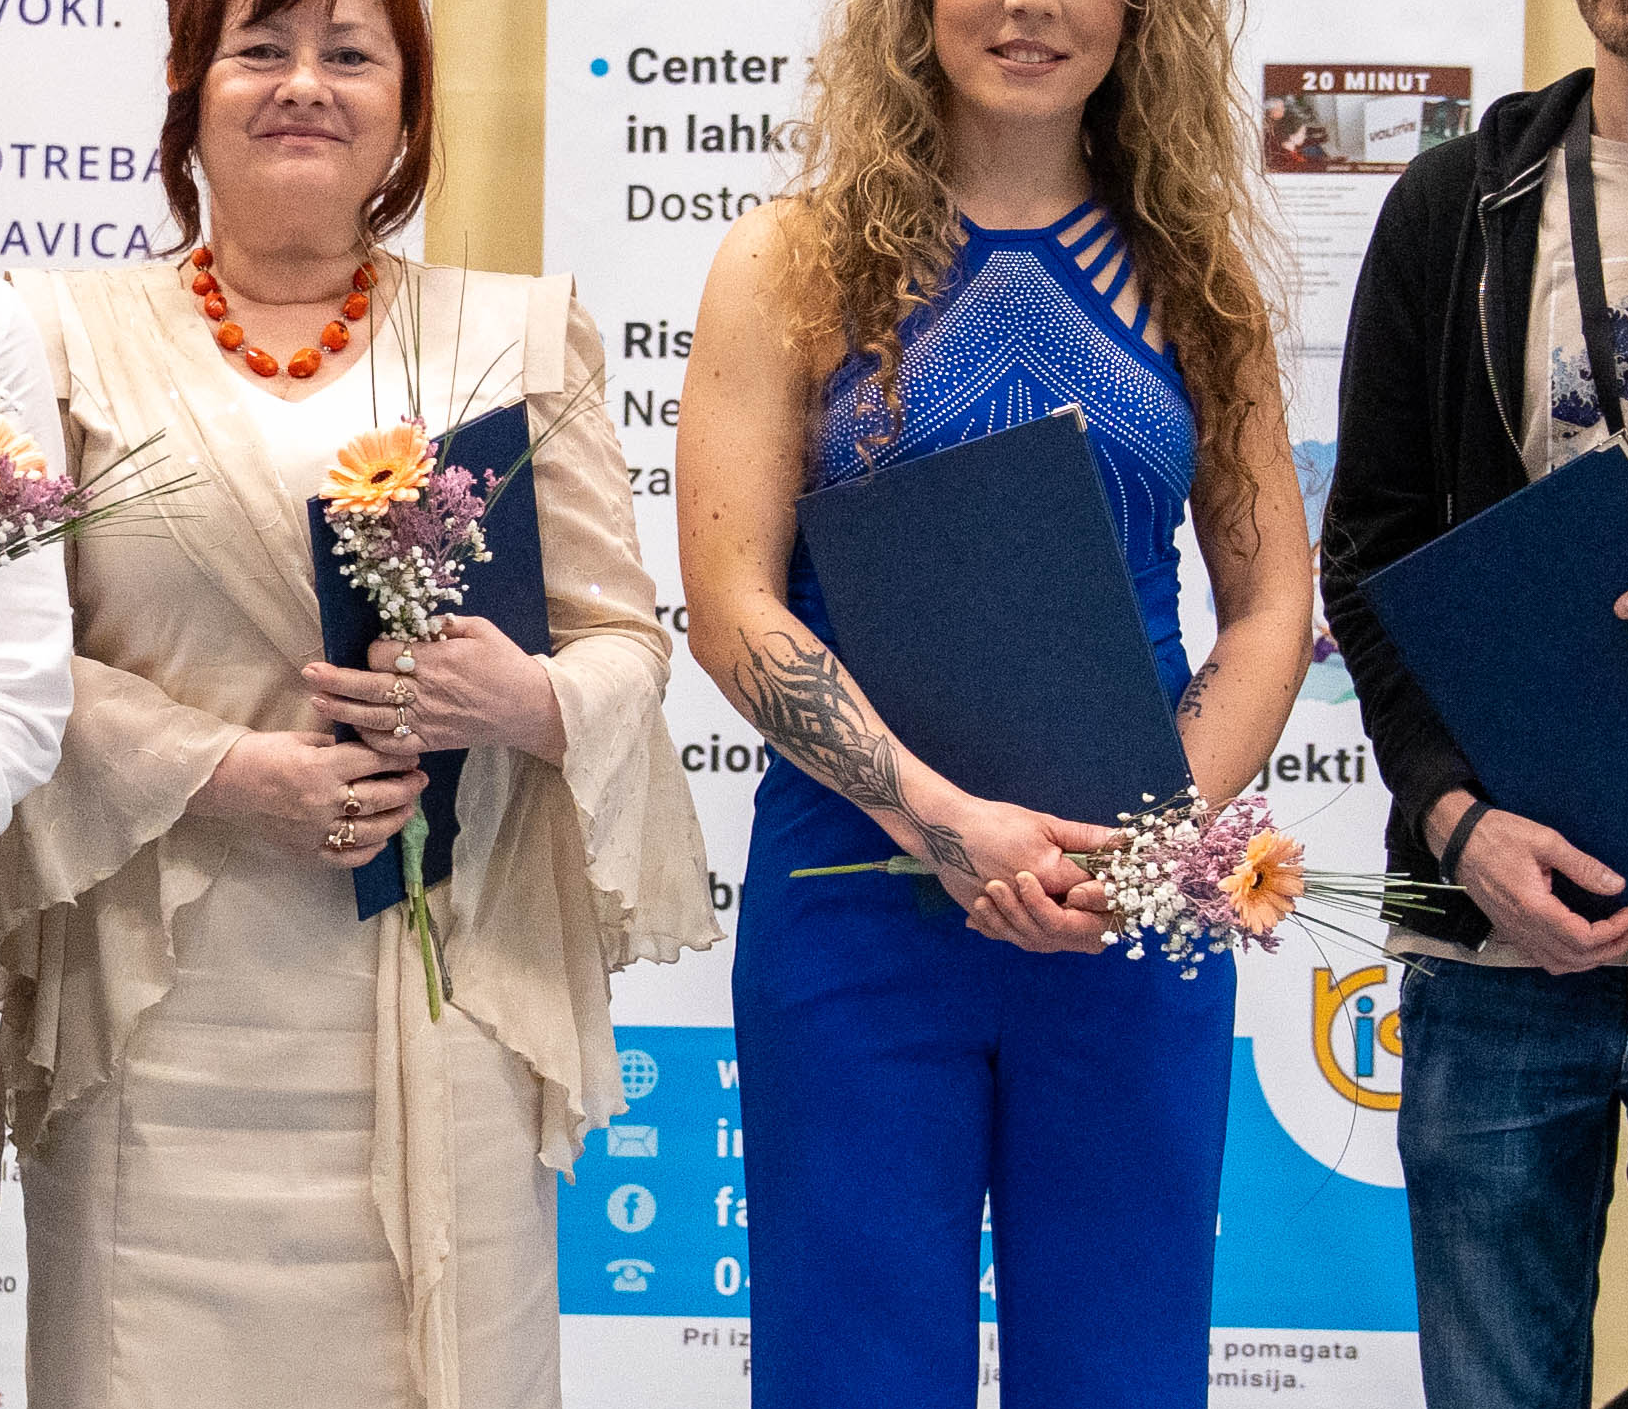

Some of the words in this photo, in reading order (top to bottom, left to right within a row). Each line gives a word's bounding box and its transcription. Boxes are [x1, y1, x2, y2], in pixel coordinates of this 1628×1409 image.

[627, 47, 788, 85] Center
[1302, 70, 1335, 92] 20
[1343, 71, 1432, 93] MINUT
[627, 114, 667, 153] in
[627, 184, 762, 222] Dosto
[1256, 743, 1366, 792] jekti
[683, 1327, 718, 1347] Pri
[1224, 1340, 1360, 1365] pomagata
[1208, 1369, 1306, 1394] omisija.
